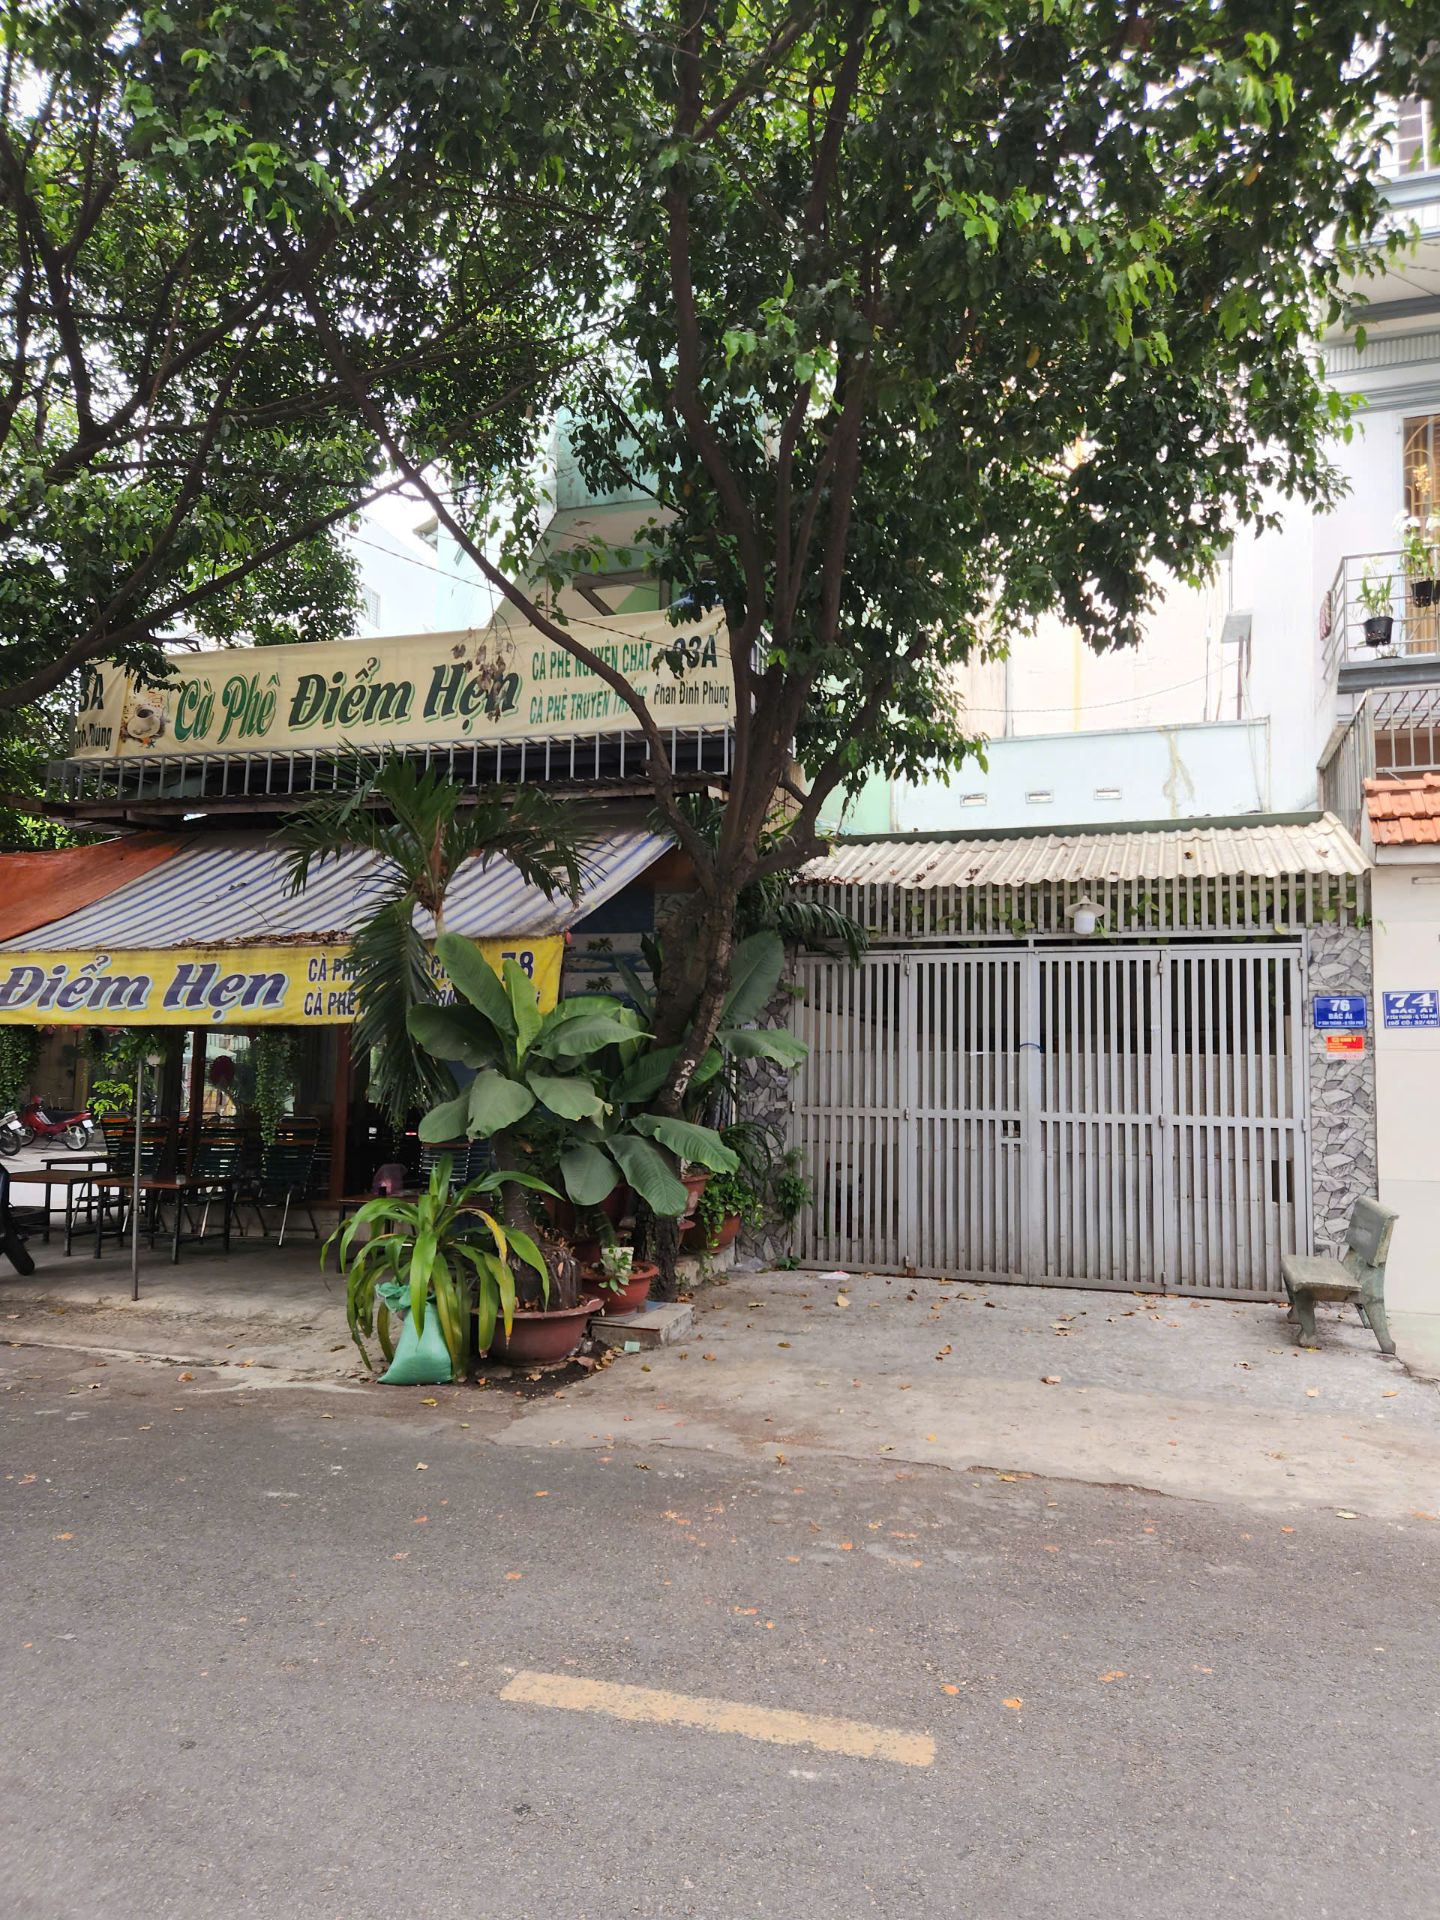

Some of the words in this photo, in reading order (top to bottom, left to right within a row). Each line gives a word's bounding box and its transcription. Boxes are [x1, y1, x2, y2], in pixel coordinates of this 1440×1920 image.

[532, 645, 547, 681] CÀ
[174, 678, 214, 743] Cà
[217, 671, 281, 745] Phê
[288, 657, 416, 732] Điểm
[423, 662, 522, 735] Hẹn
[530, 688, 544, 724] CÀ
[546, 688, 568, 722] PHÊ
[571, 681, 611, 720] TRUYỀN
[654, 683, 676, 705] Phan
[679, 680, 699, 705] Đình
[702, 680, 730, 708] Phùng
[308, 953, 327, 982] CÀ
[0, 954, 153, 1011] Điểm
[163, 963, 289, 1022] Hẹn
[304, 986, 323, 1016] CÀ
[1389, 993, 1435, 1008] 74
[1328, 1012, 1344, 1020] BÁC
[1345, 1012, 1353, 1020] ÁI
[1330, 1000, 1351, 1012] 76
